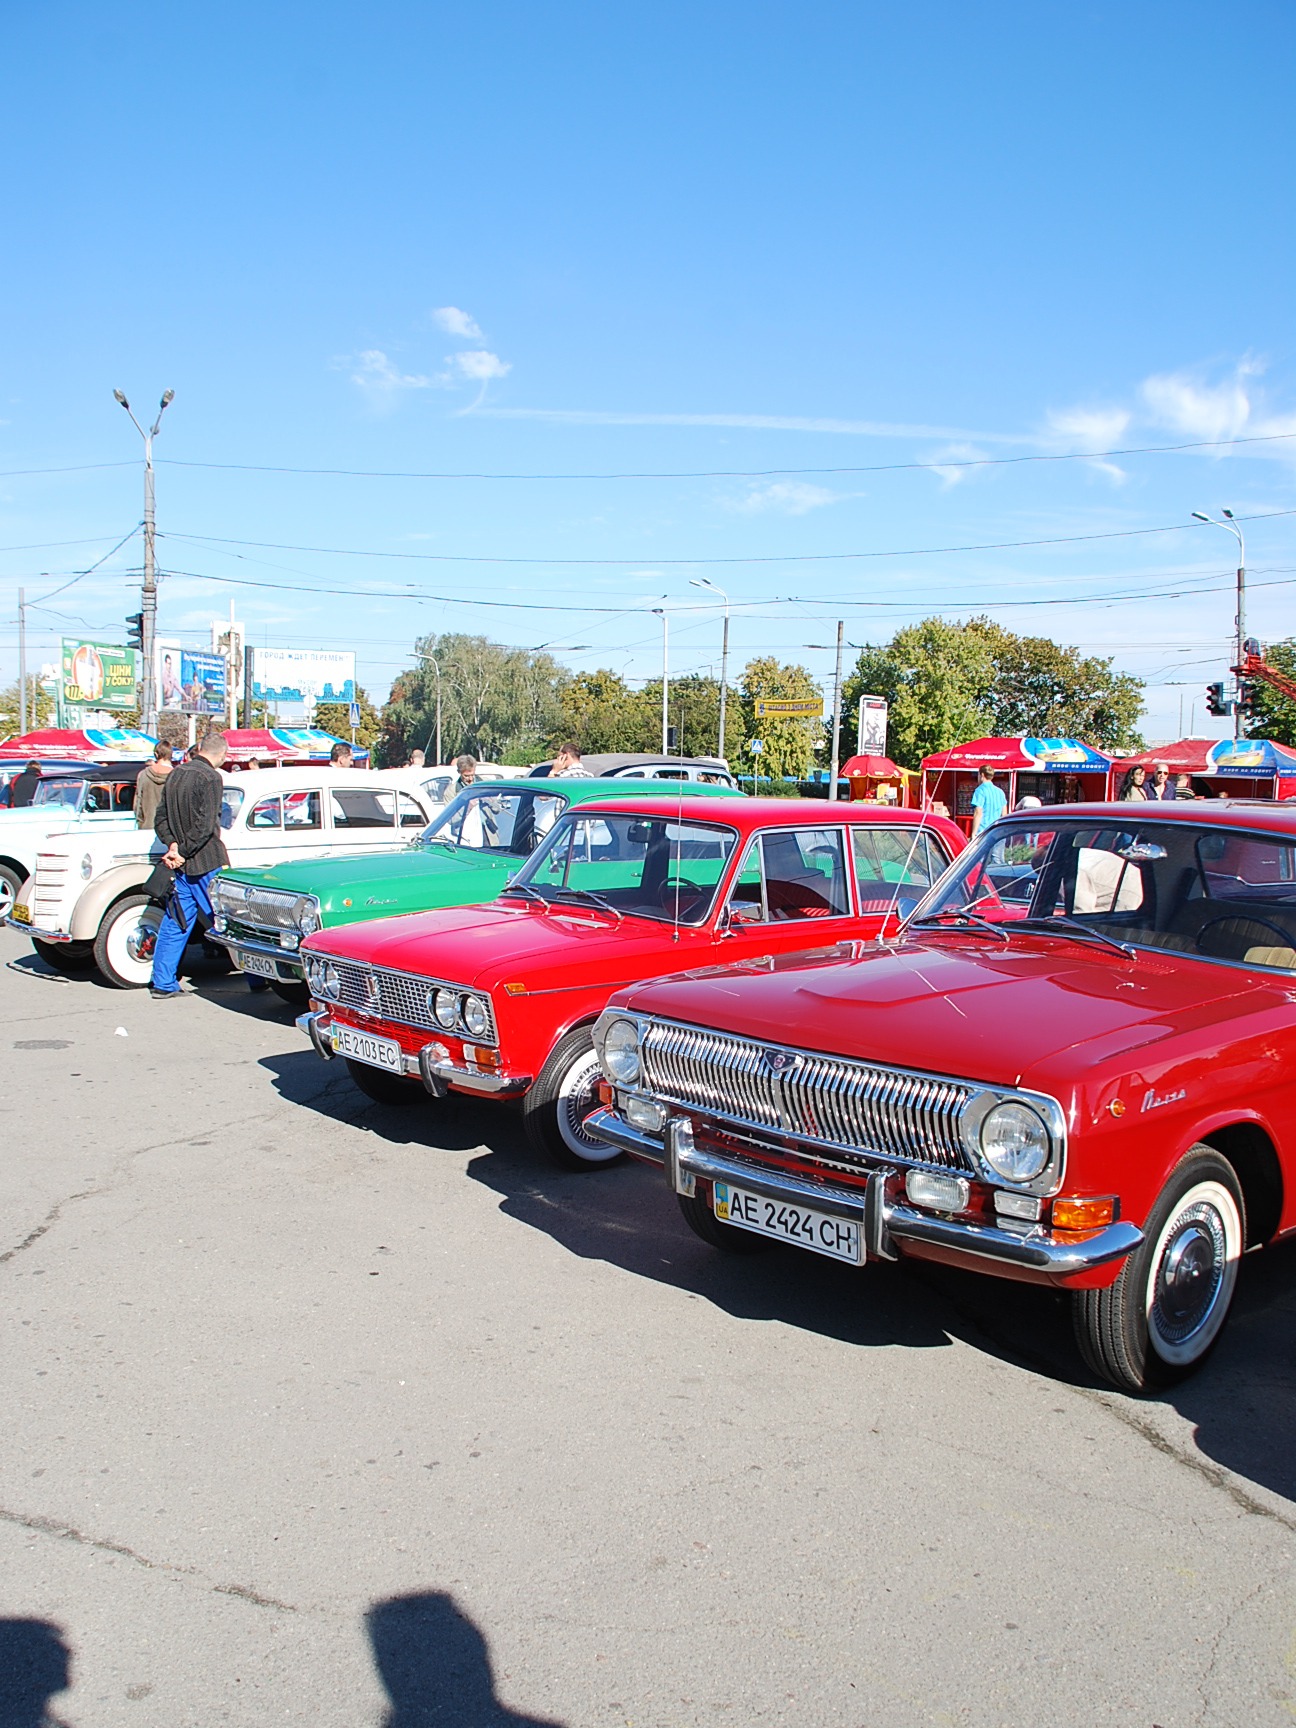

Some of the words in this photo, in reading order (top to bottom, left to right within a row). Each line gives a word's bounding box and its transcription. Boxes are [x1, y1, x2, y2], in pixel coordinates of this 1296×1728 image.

[260, 651, 284, 660] ГОРОД
[251, 956, 265, 972] 2424
[338, 1031, 351, 1052] AE
[353, 1036, 377, 1060] 2103
[379, 1044, 397, 1066] EC
[718, 1205, 729, 1215] UA
[730, 1192, 759, 1224] AE
[764, 1202, 814, 1242] 2424
[819, 1219, 851, 1254] CH
